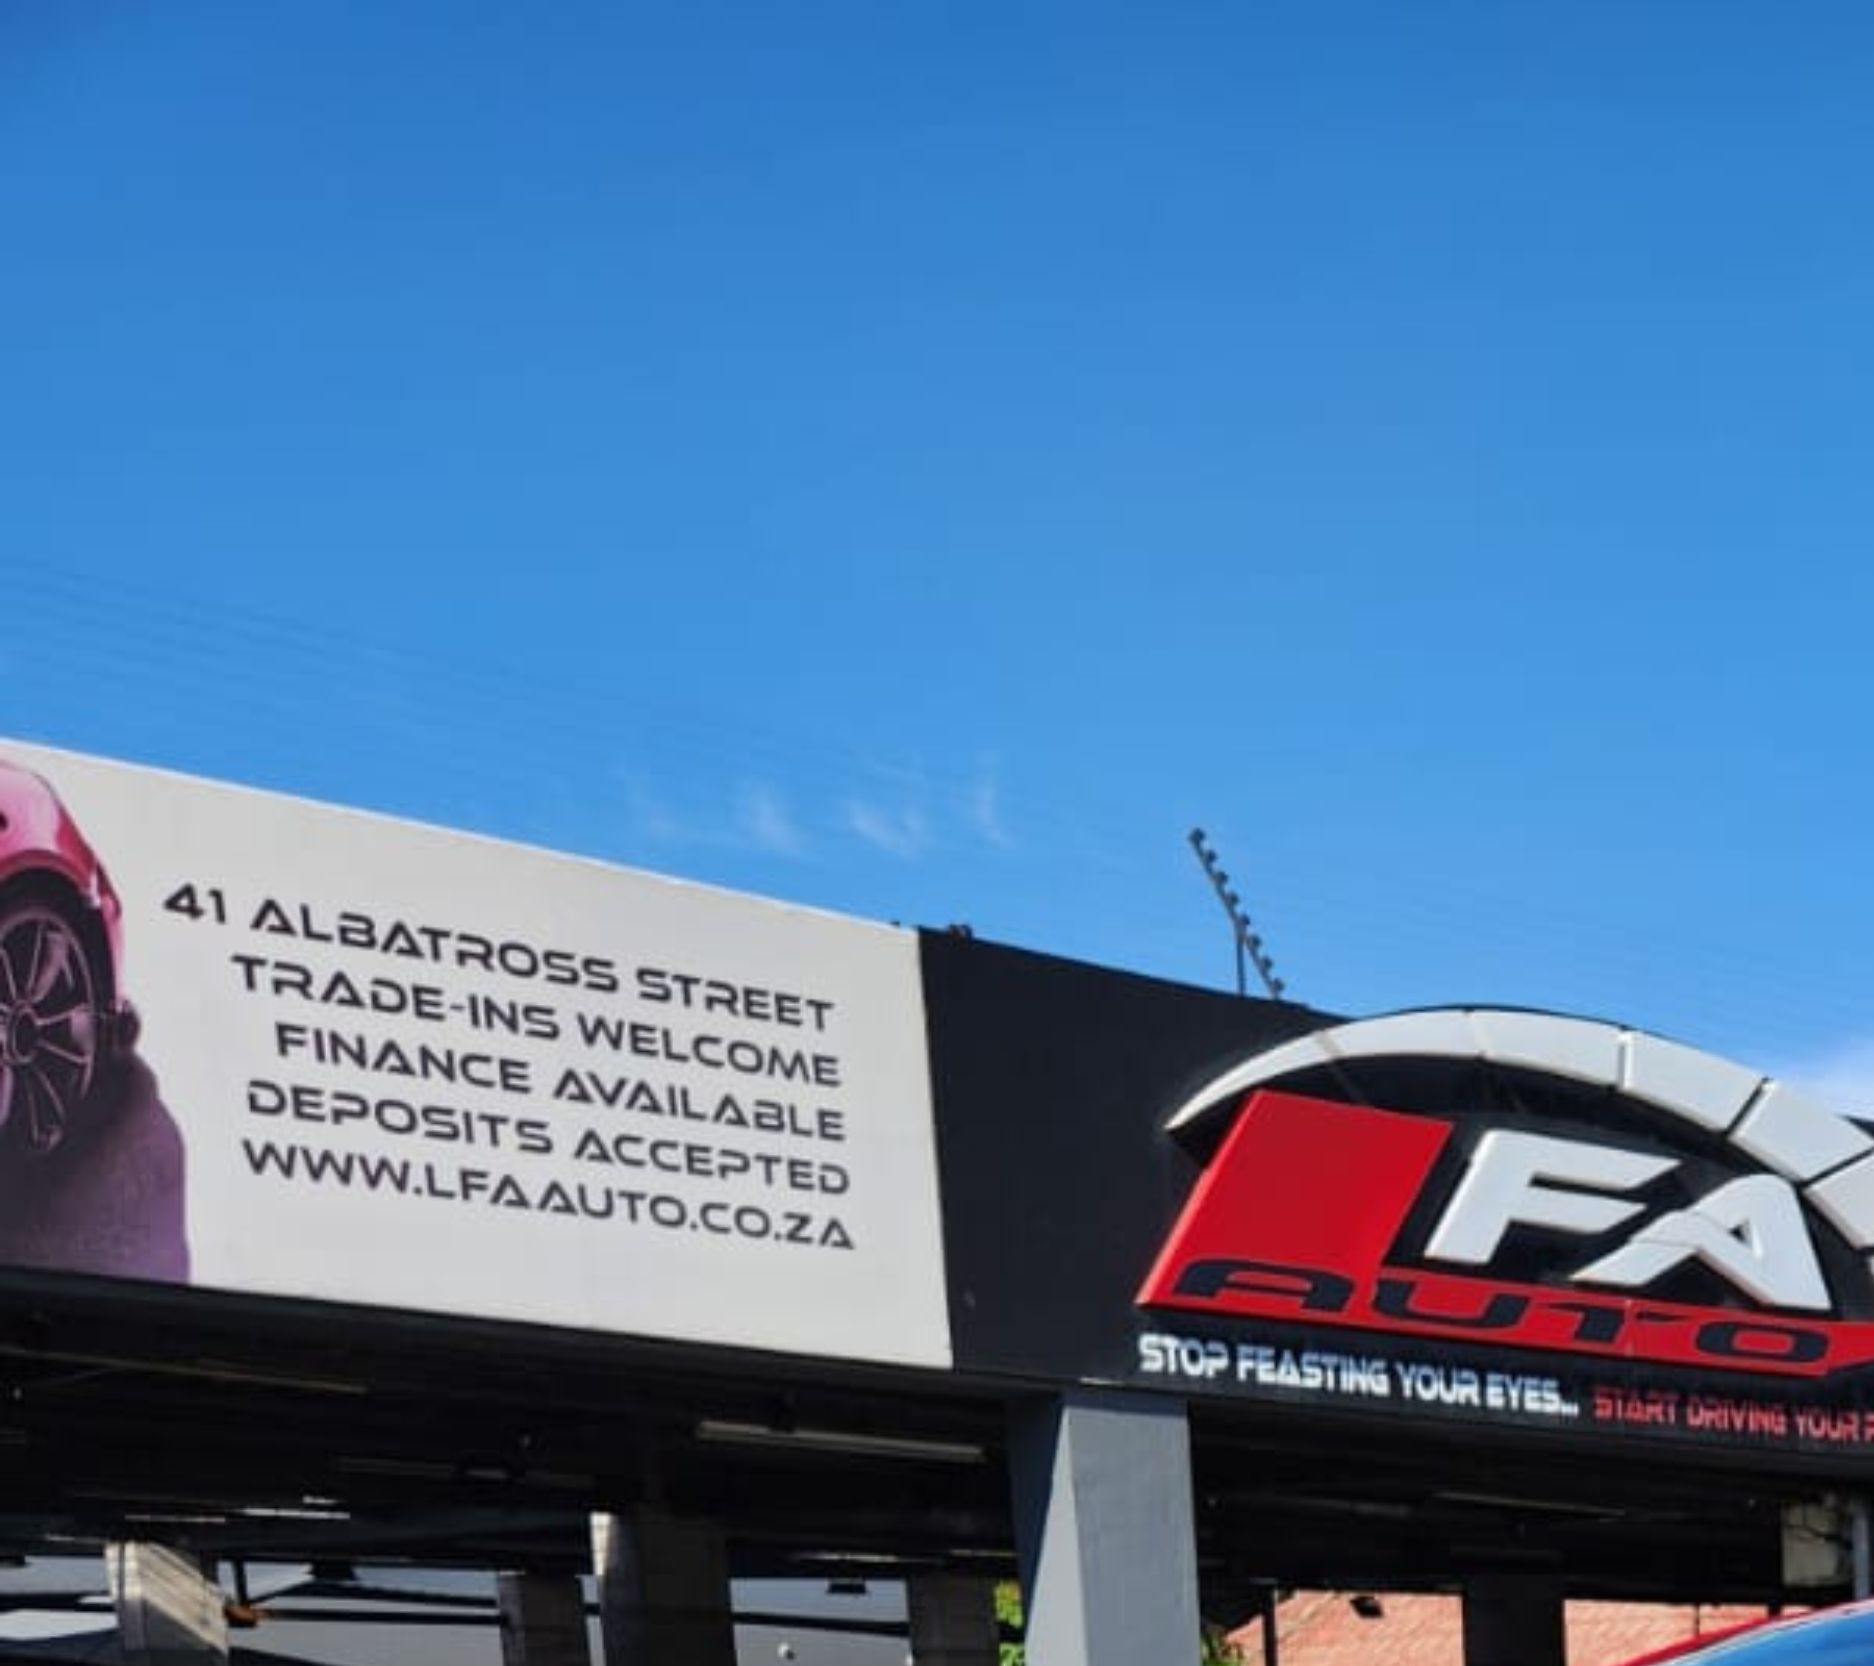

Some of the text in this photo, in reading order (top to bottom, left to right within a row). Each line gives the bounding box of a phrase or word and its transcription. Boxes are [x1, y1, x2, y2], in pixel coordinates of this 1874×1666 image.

[163, 883, 834, 1031] 41 ALBATROSS STREET
[232, 955, 840, 1087] TRADE-INS WELCOME
[248, 1080, 849, 1195] DEPOSITS ACCEPTED
[276, 1023, 844, 1142] FINANCE AVAILABLE
[243, 1140, 853, 1250] WWW.LFAAUTO.CO.ZA
[1172, 1258, 1832, 1365] AUTO
[1138, 1332, 1229, 1378] STOP
[1235, 1343, 1391, 1396] FEASTING
[1395, 1361, 1479, 1407] YOUR
[1591, 1384, 1679, 1425] START
[1686, 1397, 1787, 1437] DRIVING
[1796, 1406, 1860, 1442] YOUR
